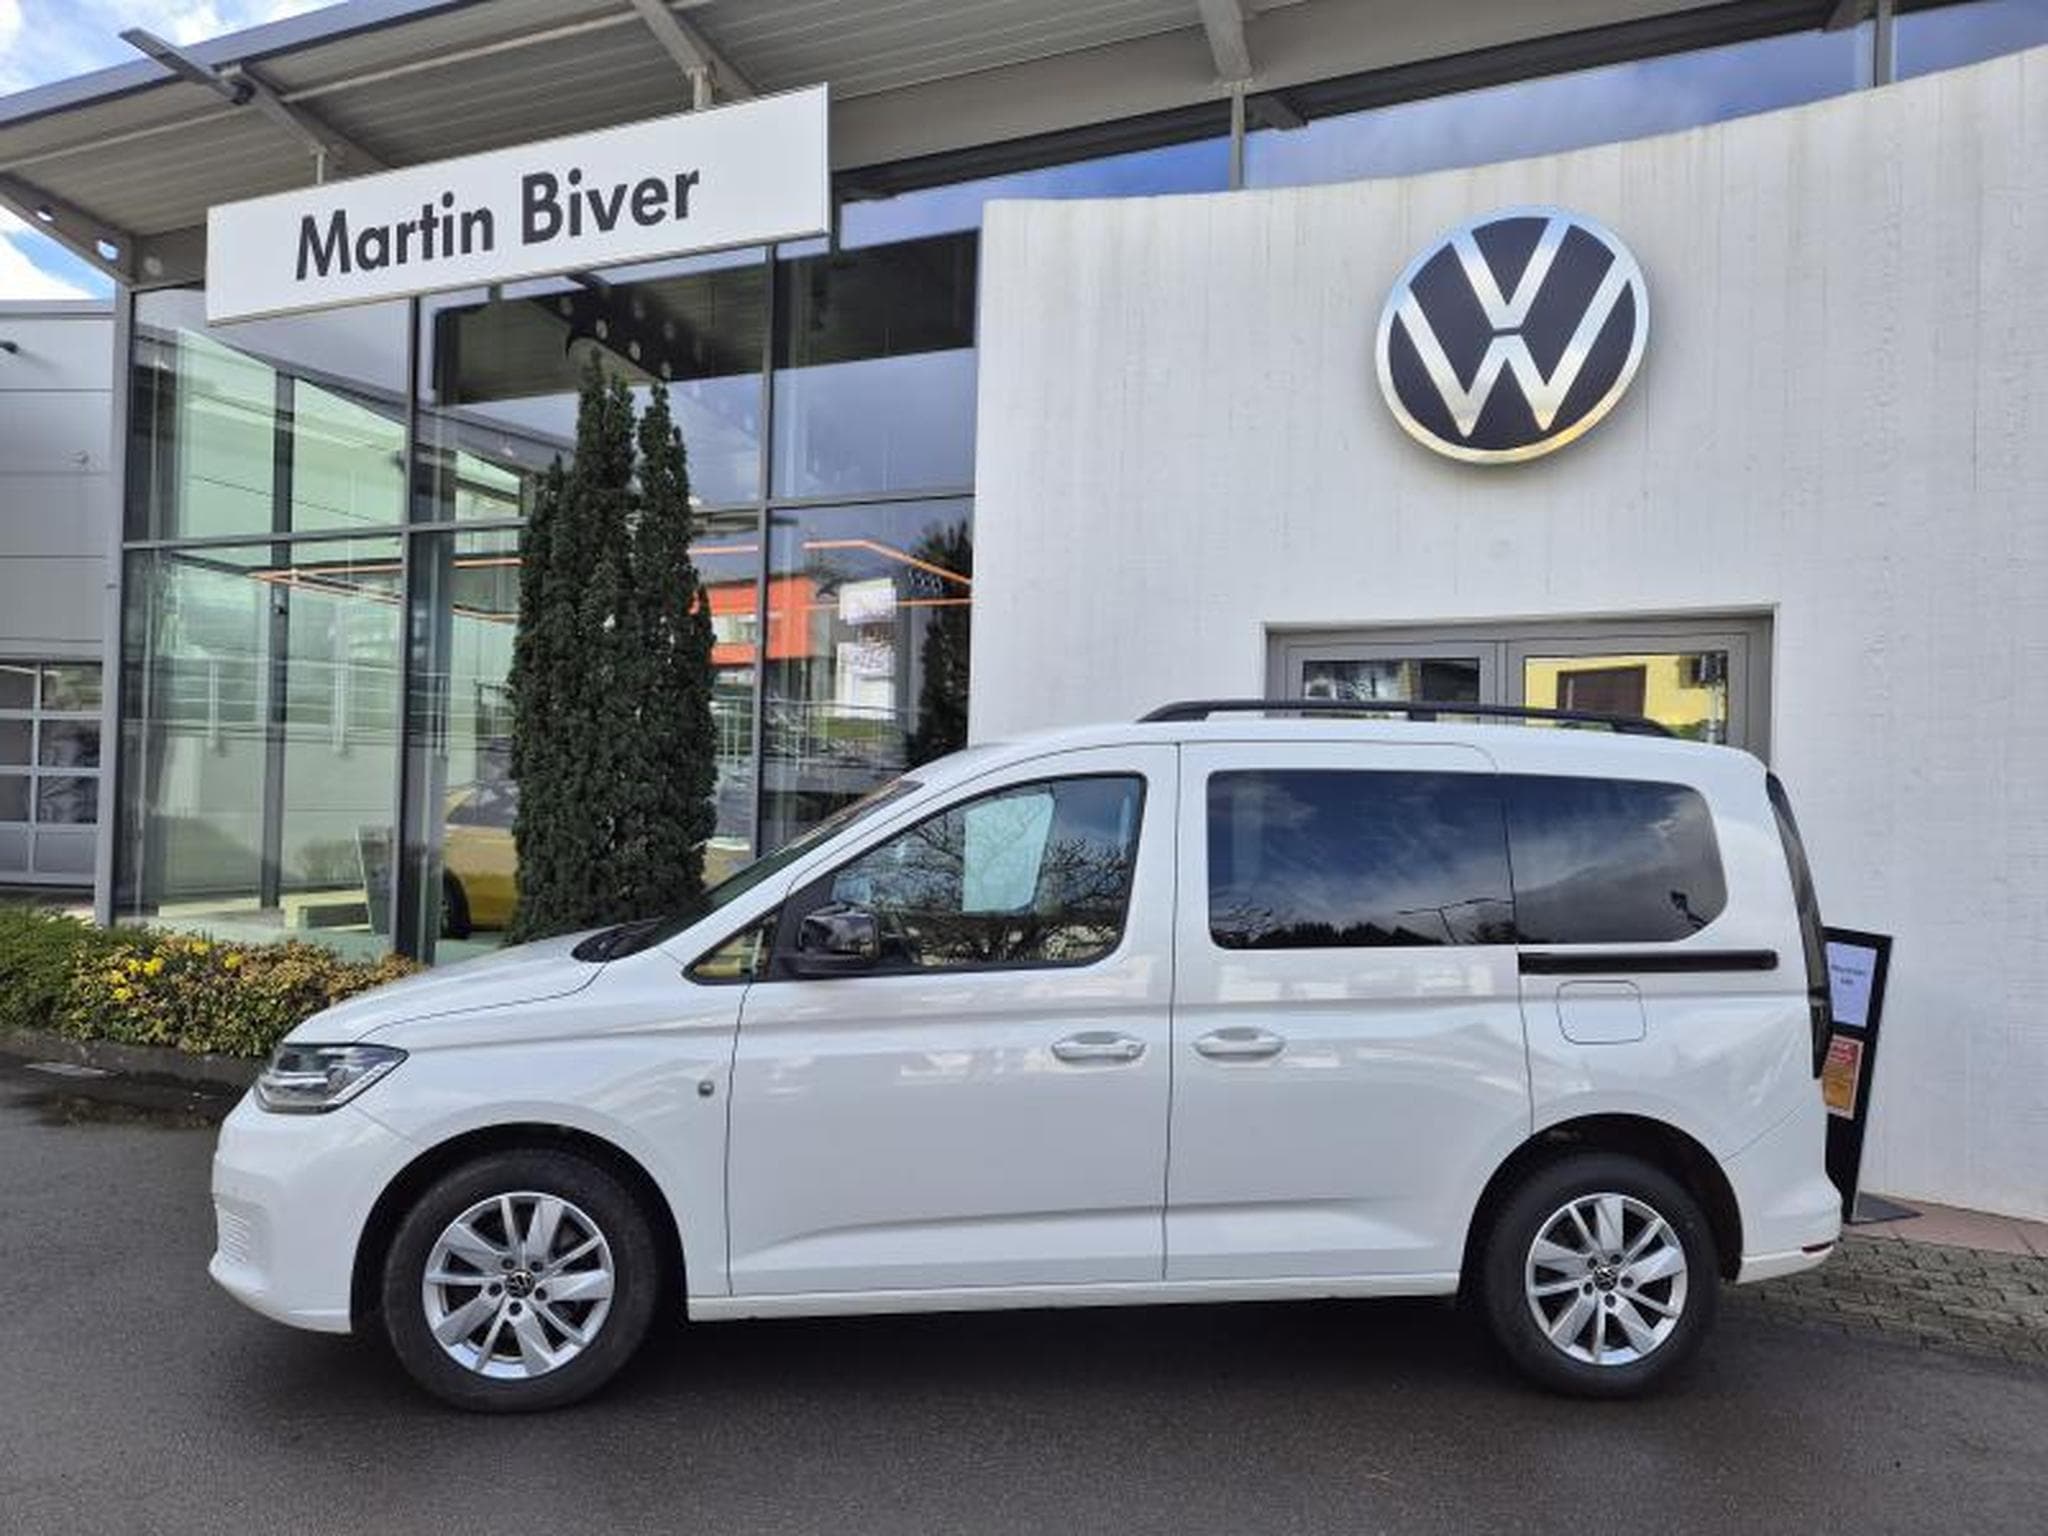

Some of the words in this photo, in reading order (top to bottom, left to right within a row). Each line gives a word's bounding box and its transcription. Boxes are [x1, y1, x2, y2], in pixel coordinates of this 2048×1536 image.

[297, 192, 494, 280] Martin
[521, 168, 700, 244] Biver
[1388, 214, 1634, 438] VW
